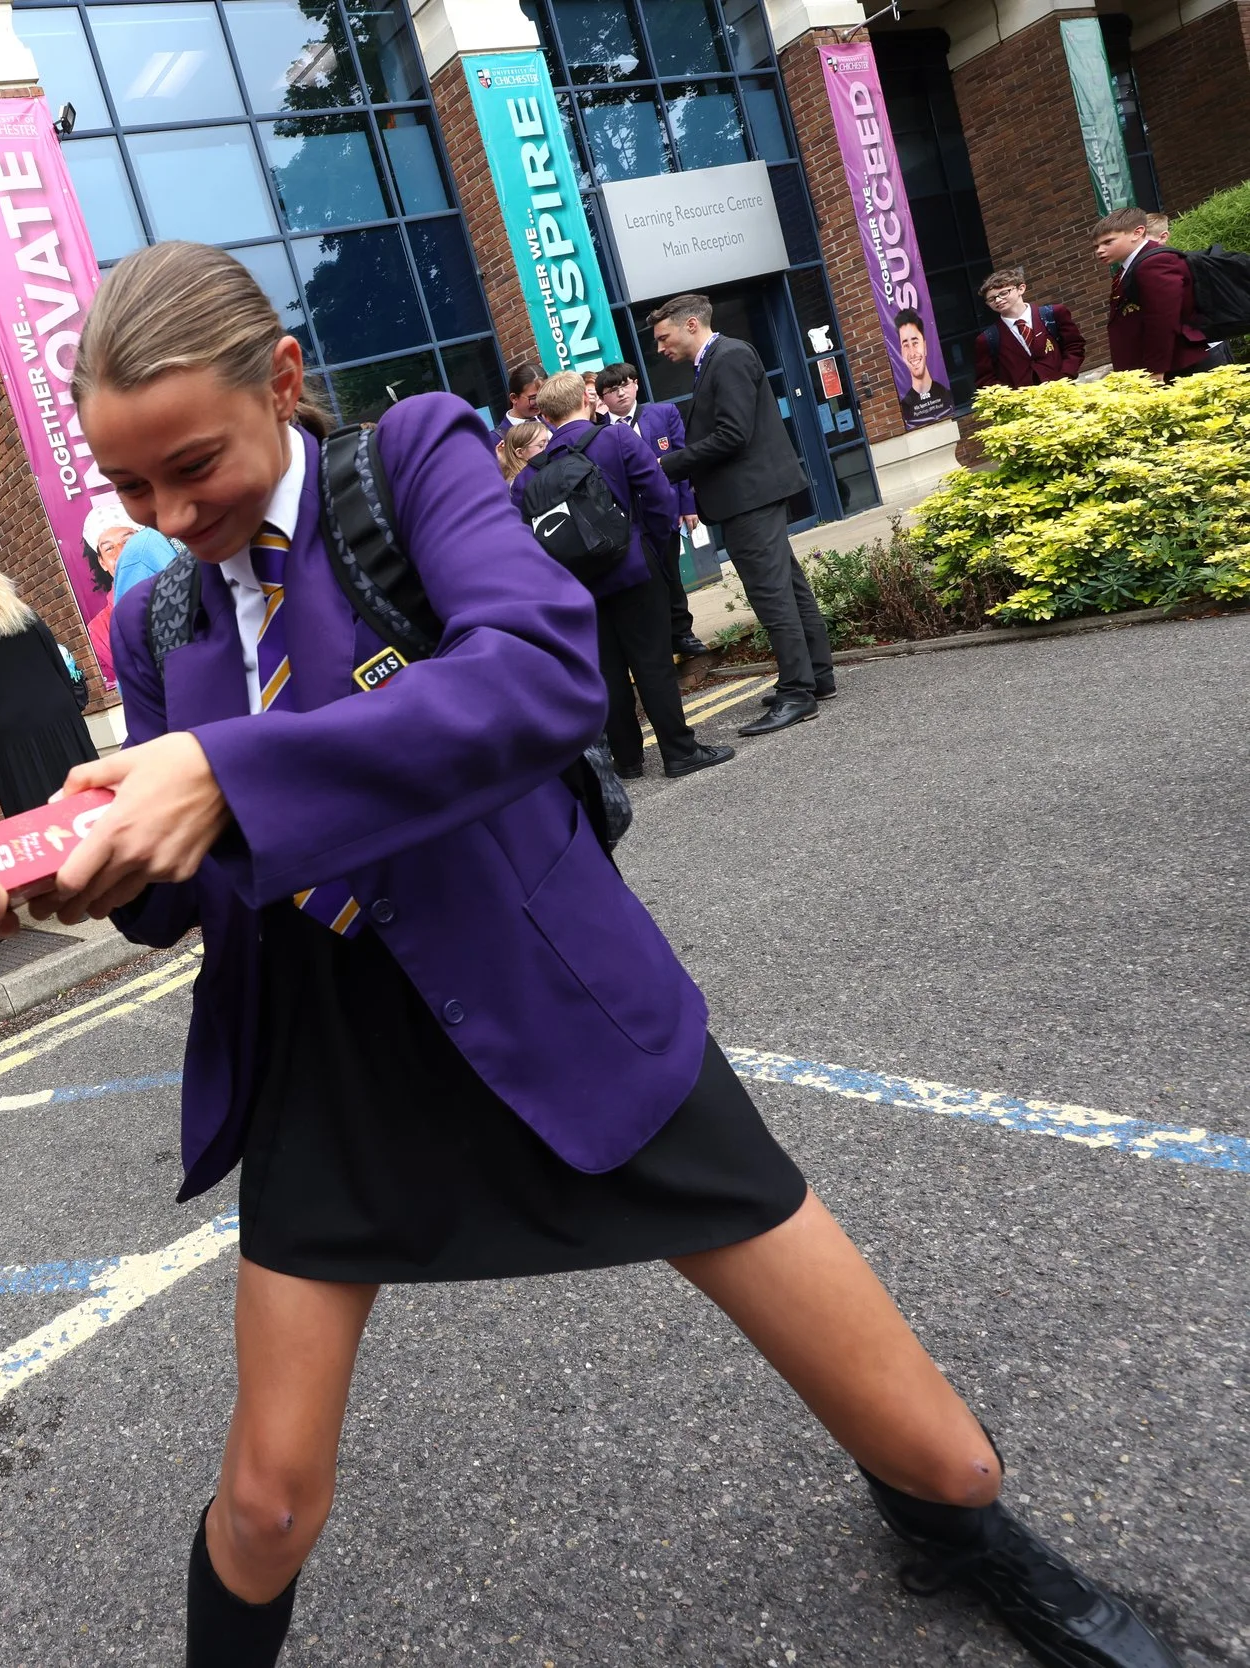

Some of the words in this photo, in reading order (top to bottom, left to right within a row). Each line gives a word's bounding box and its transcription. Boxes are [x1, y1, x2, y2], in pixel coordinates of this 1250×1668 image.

[494, 74, 539, 85] CHICHESTER
[506, 96, 604, 375] INSPIRE
[624, 210, 675, 229] Learning
[674, 202, 725, 221] Resource
[726, 195, 764, 211] Centre
[849, 81, 918, 311] SUCCEED
[662, 241, 690, 257] Main
[691, 231, 745, 252] Reception
[869, 217, 894, 305] TOGETHER
[535, 263, 571, 371] TOGETHER
[28, 367, 82, 500] TOGETHER
[364, 656, 399, 685] CHS
